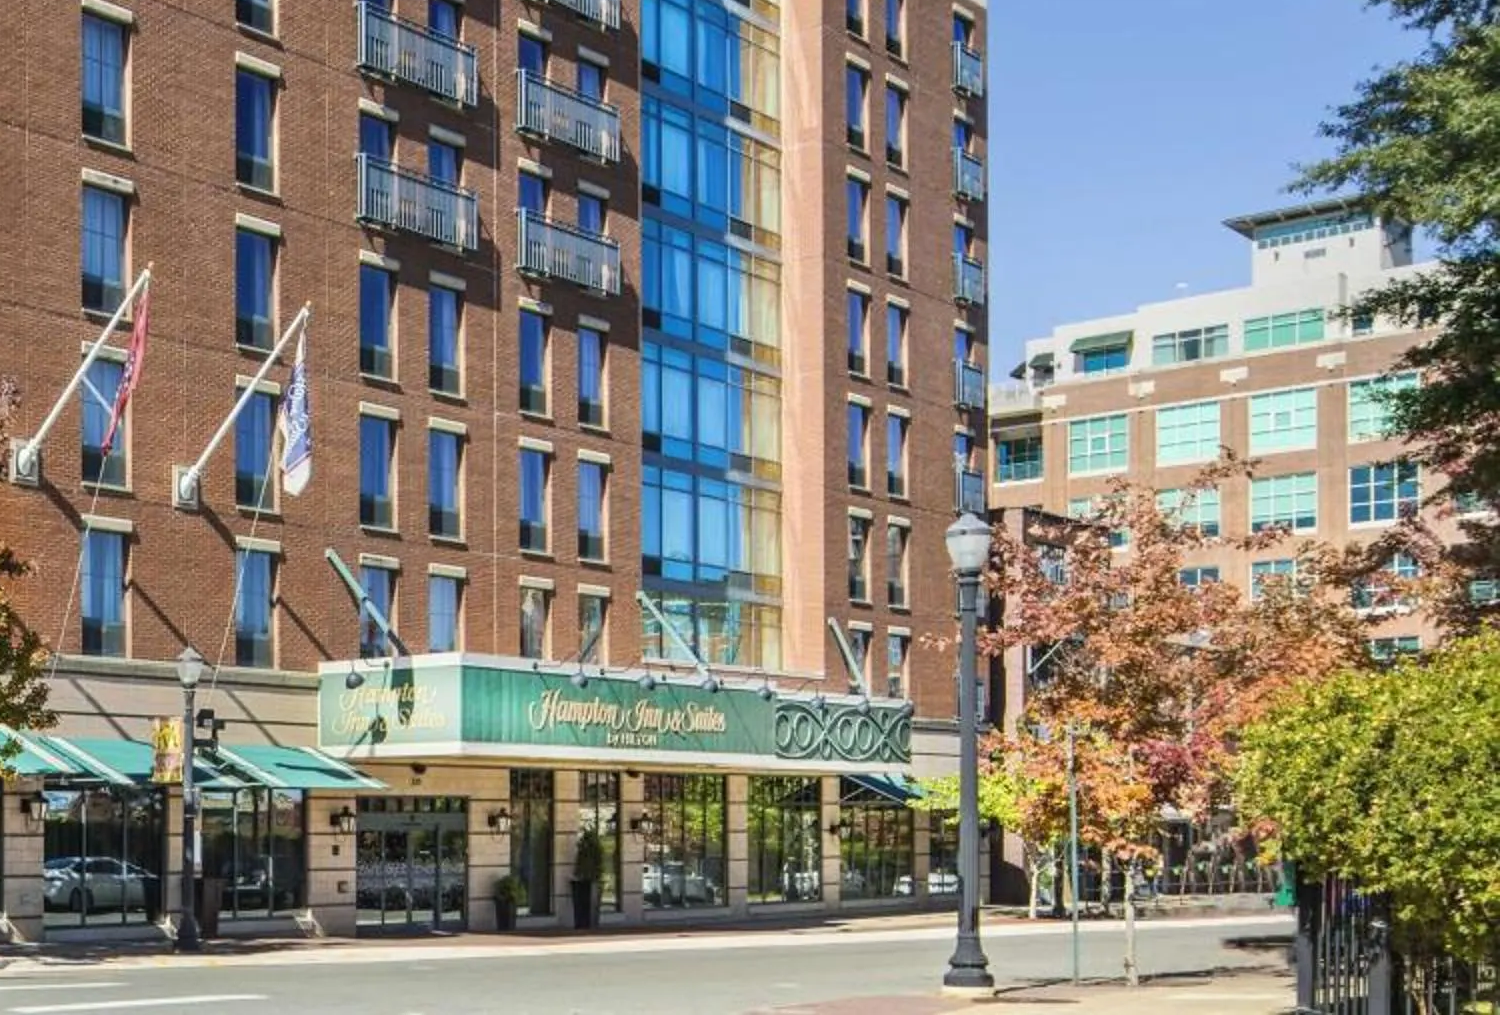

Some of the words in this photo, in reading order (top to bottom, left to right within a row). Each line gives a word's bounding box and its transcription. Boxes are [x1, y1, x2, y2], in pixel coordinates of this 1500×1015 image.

[340, 683, 437, 711] Hampton
[529, 688, 625, 730] Hampton
[626, 698, 670, 733] Inn
[670, 707, 683, 733] &
[681, 701, 726, 733] Suites
[620, 733, 658, 747] HILTON
